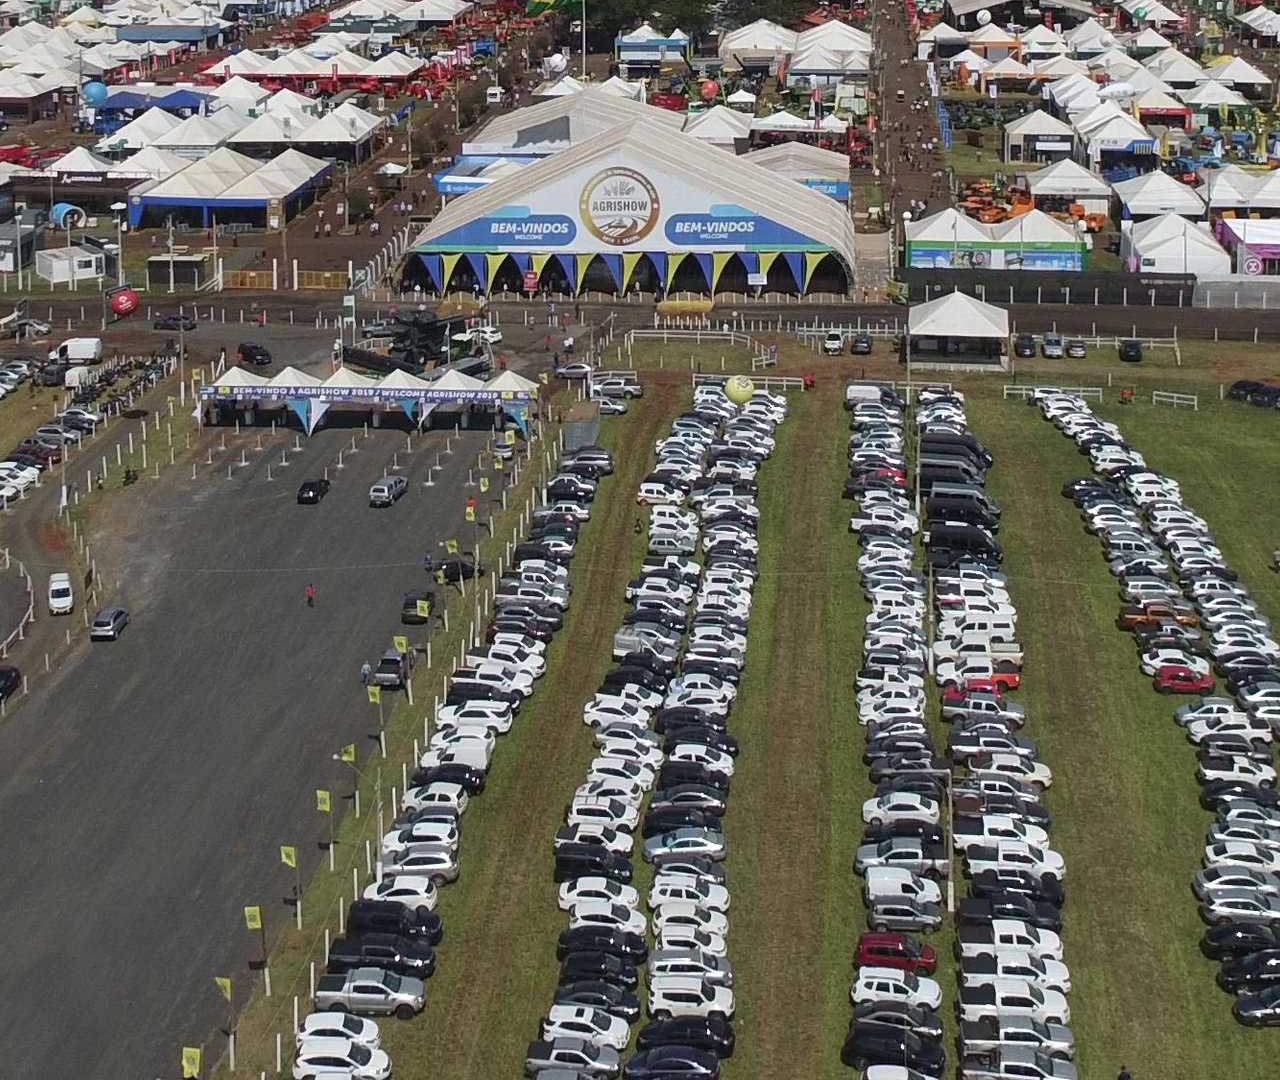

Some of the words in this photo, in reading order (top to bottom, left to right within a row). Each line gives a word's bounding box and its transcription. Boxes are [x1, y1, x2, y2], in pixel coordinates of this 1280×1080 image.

[592, 201, 648, 212] AGRISHOW
[490, 222, 569, 234] BEM-VINDOS
[675, 221, 755, 233] BEM-VINDOS
[233, 387, 287, 395] BEM-VINDO
[297, 387, 349, 396] AGRISHOW
[351, 388, 374, 396] 2019
[381, 390, 425, 398] WELCOME
[426, 391, 476, 399] AGRISHOW
